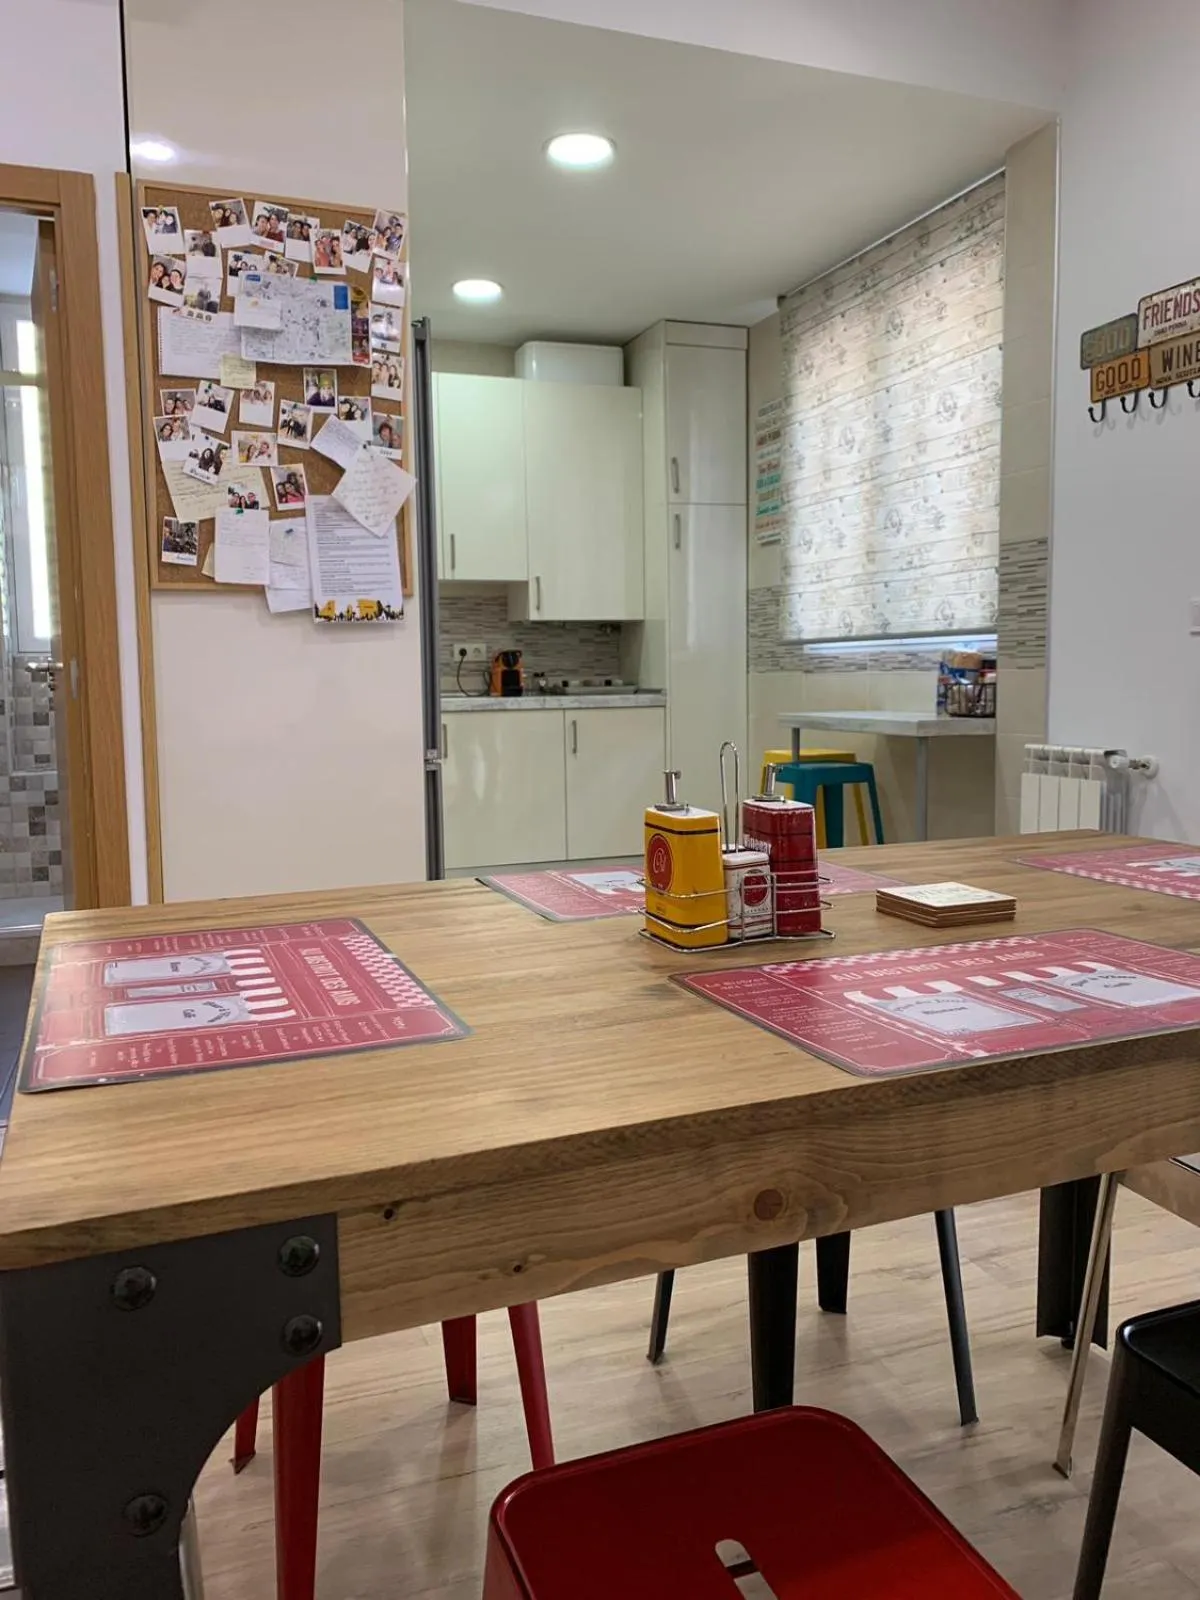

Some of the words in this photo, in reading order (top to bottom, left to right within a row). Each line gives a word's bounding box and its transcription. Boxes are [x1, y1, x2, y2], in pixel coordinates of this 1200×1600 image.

[1143, 288, 1200, 330] FRIENDS
[1162, 340, 1200, 373] WINE
[1096, 358, 1141, 392] GOOD
